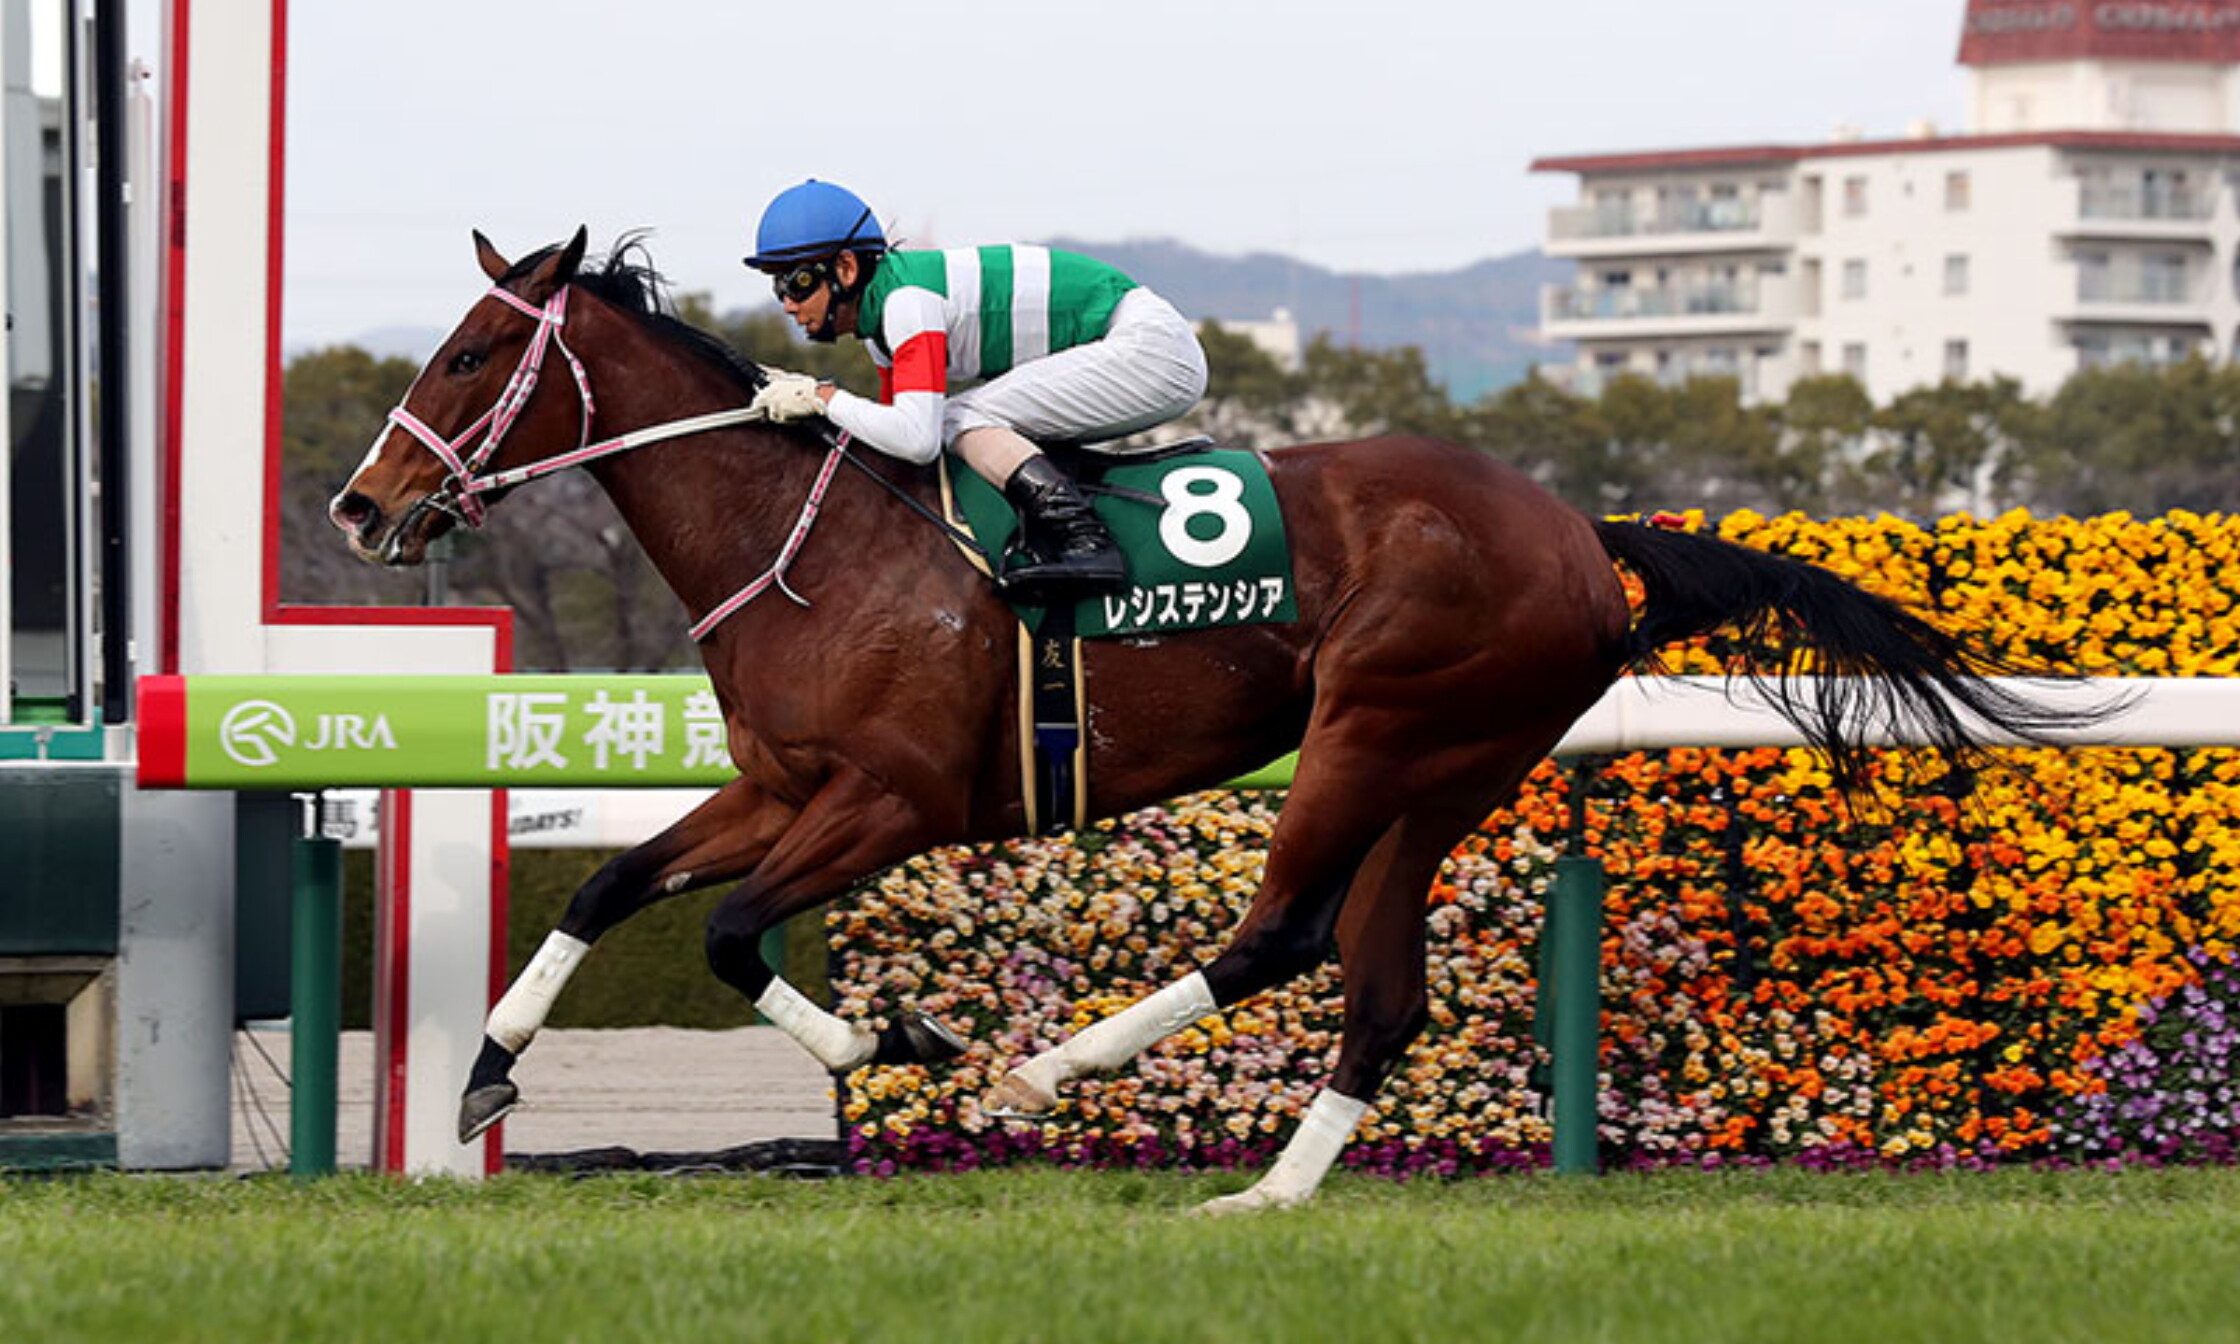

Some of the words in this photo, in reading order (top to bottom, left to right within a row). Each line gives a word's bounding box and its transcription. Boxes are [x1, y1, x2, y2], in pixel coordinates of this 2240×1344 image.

[1159, 466, 1252, 567] 8
[1104, 577, 1284, 629] レシステンシア
[304, 714, 398, 750] JRA
